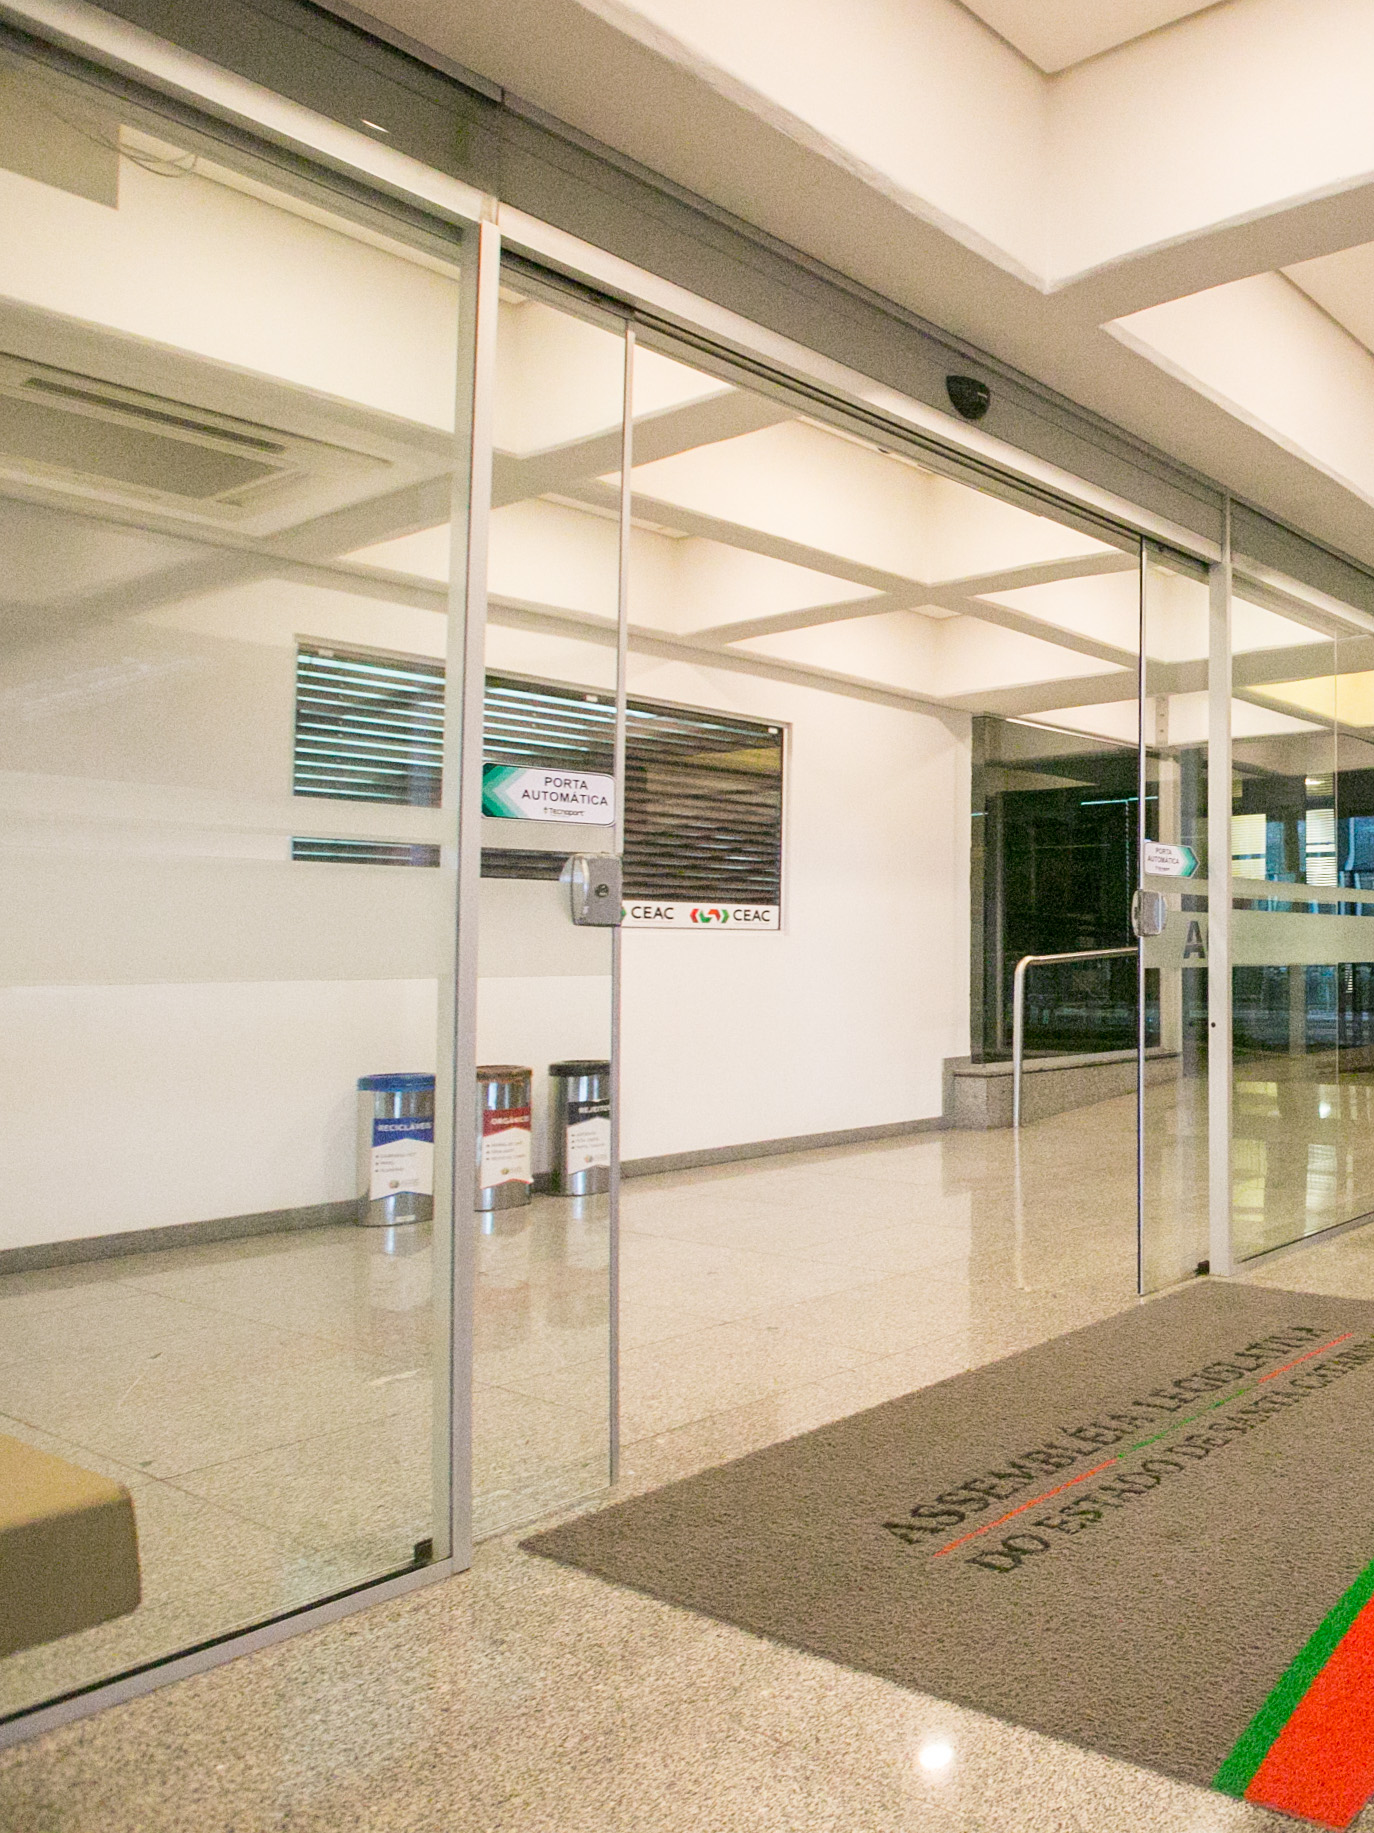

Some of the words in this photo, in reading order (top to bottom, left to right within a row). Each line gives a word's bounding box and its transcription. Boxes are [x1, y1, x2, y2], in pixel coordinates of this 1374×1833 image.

[544, 776, 588, 790] PORTA
[521, 789, 608, 806] AUTOMÁTICA
[631, 906, 674, 920] CEAC
[733, 909, 771, 922] CEAC
[965, 1533, 1050, 1573] DO
[1033, 1459, 1184, 1535] ESTADO
[1165, 1433, 1232, 1460] DE
